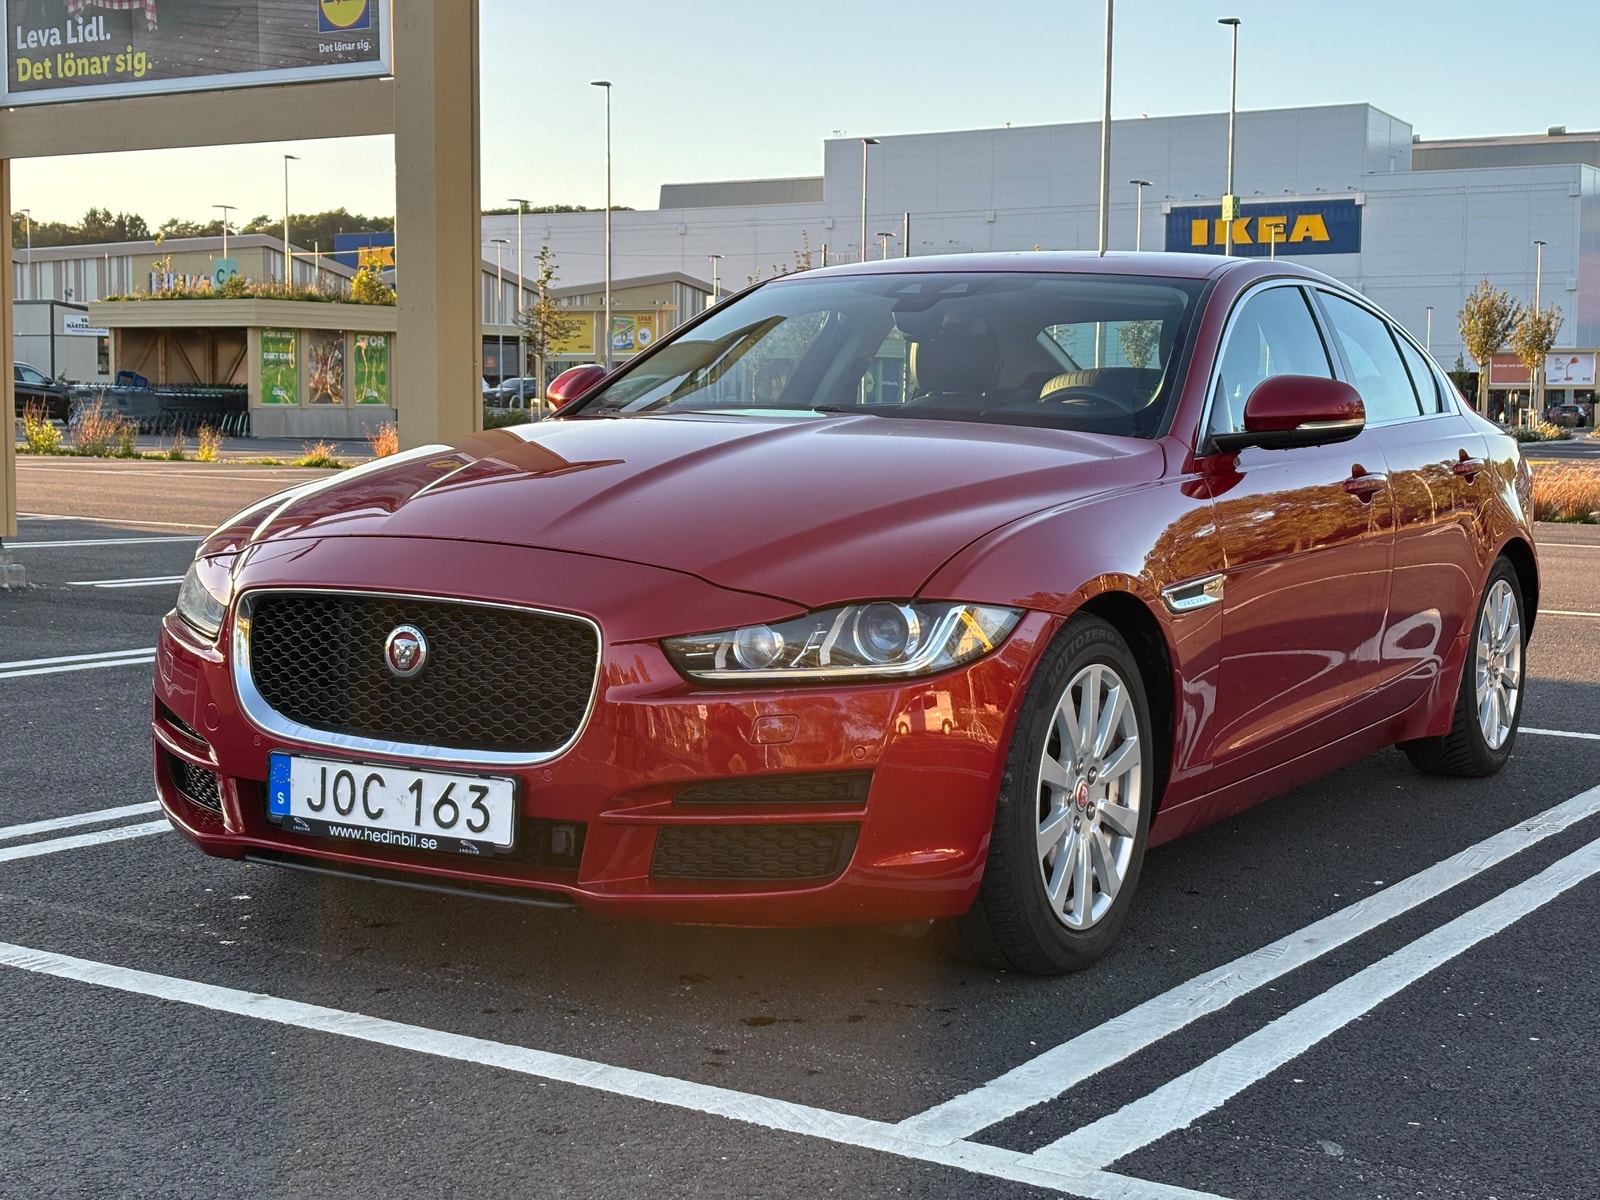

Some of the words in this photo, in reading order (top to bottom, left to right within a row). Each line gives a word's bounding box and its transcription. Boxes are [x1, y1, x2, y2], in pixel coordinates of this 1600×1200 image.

[16, 25, 62, 50] Leva
[66, 15, 111, 44] Lidl.
[318, 43, 334, 53] Det
[334, 41, 356, 52] lönar
[356, 39, 372, 51] sig.
[16, 57, 52, 82] Det
[57, 52, 111, 78] lönar
[115, 44, 153, 78] sig.
[1191, 213, 1331, 246] IKEA
[357, 335, 385, 347] STOR
[277, 791, 285, 805] S
[306, 766, 386, 820] JOC
[408, 778, 491, 834] 163
[329, 824, 438, 850] www.hedinbil.se
